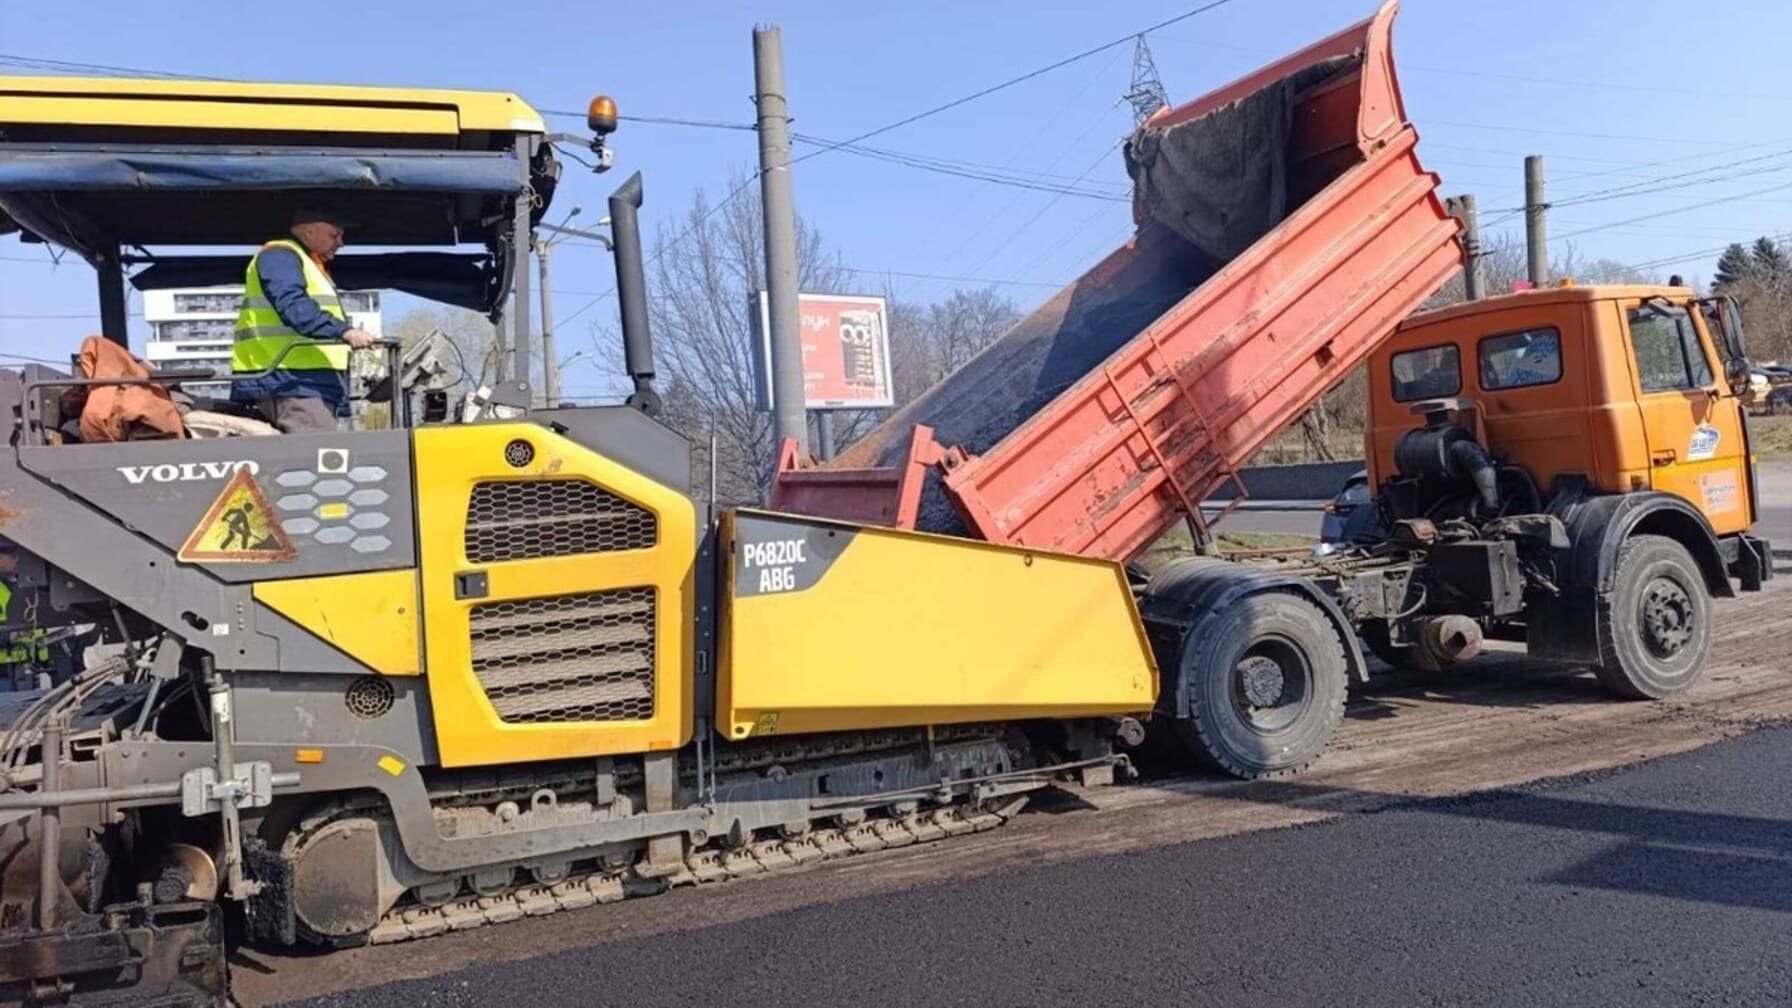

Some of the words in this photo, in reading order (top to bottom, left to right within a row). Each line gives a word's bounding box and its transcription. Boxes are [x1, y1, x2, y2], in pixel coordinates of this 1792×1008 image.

[117, 460, 260, 484] VOLVO
[743, 539, 807, 568] P6820C
[759, 566, 795, 593] ABG
